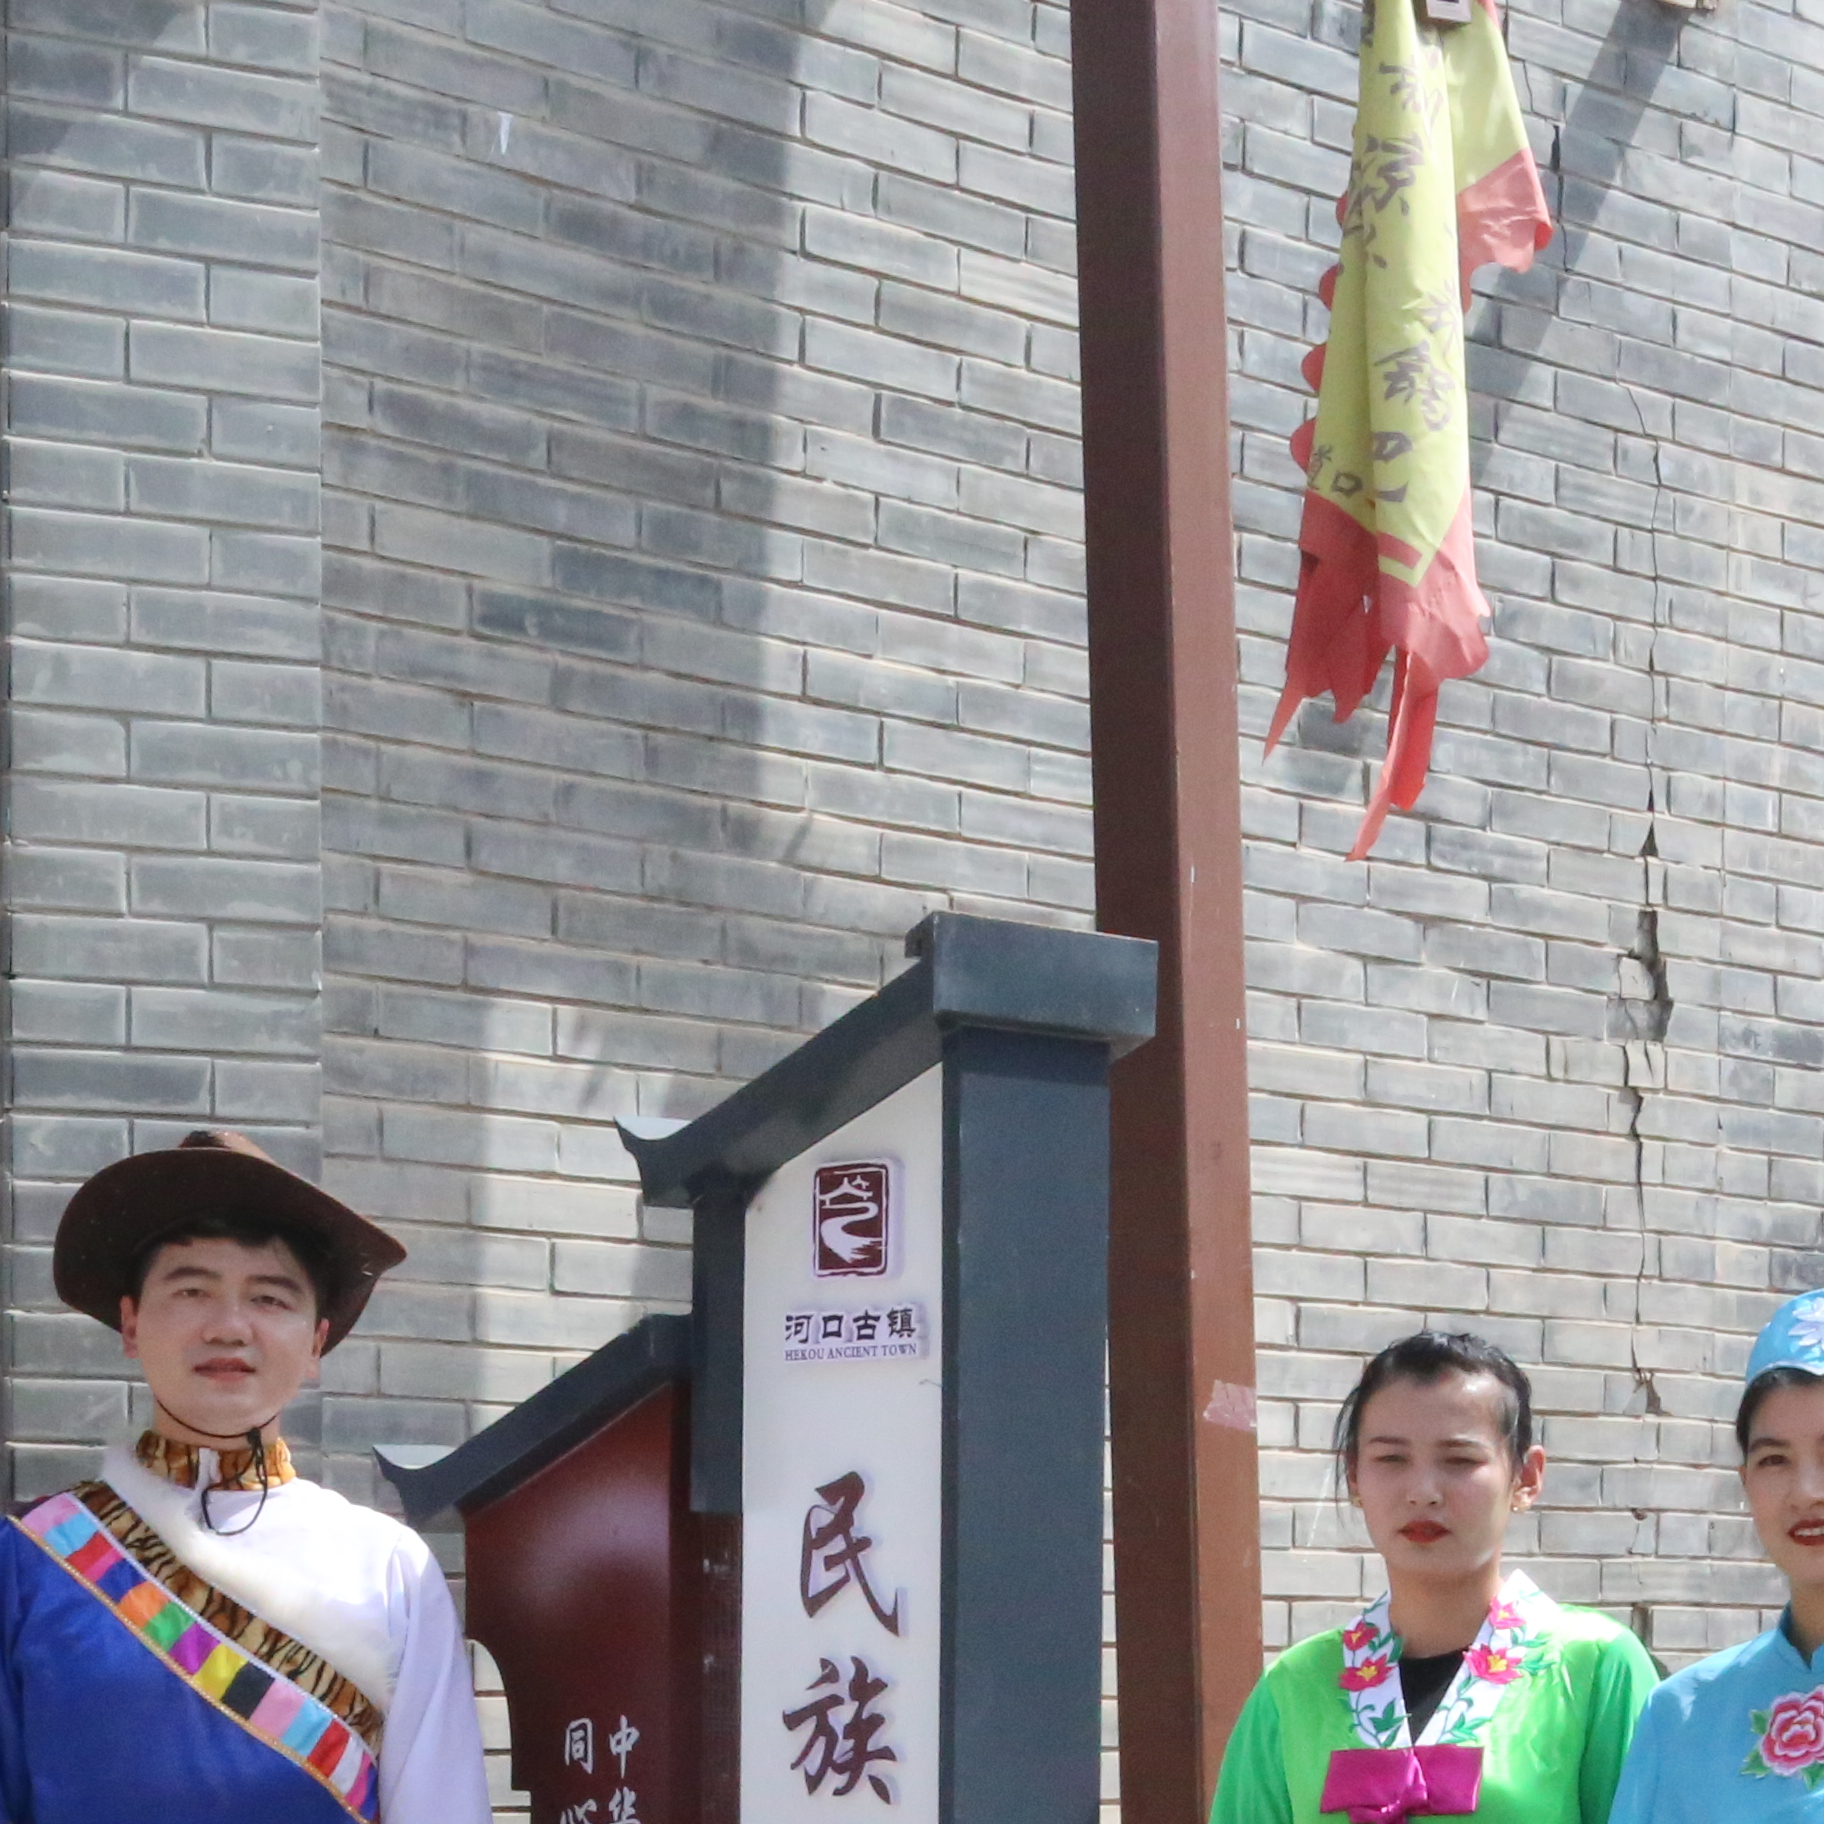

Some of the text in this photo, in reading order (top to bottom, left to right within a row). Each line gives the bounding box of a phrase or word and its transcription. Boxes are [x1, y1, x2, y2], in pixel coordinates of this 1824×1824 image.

[785, 1308, 917, 1344] 河口古镇
[785, 1343, 917, 1361] HEKOU ANCIENT TOWN
